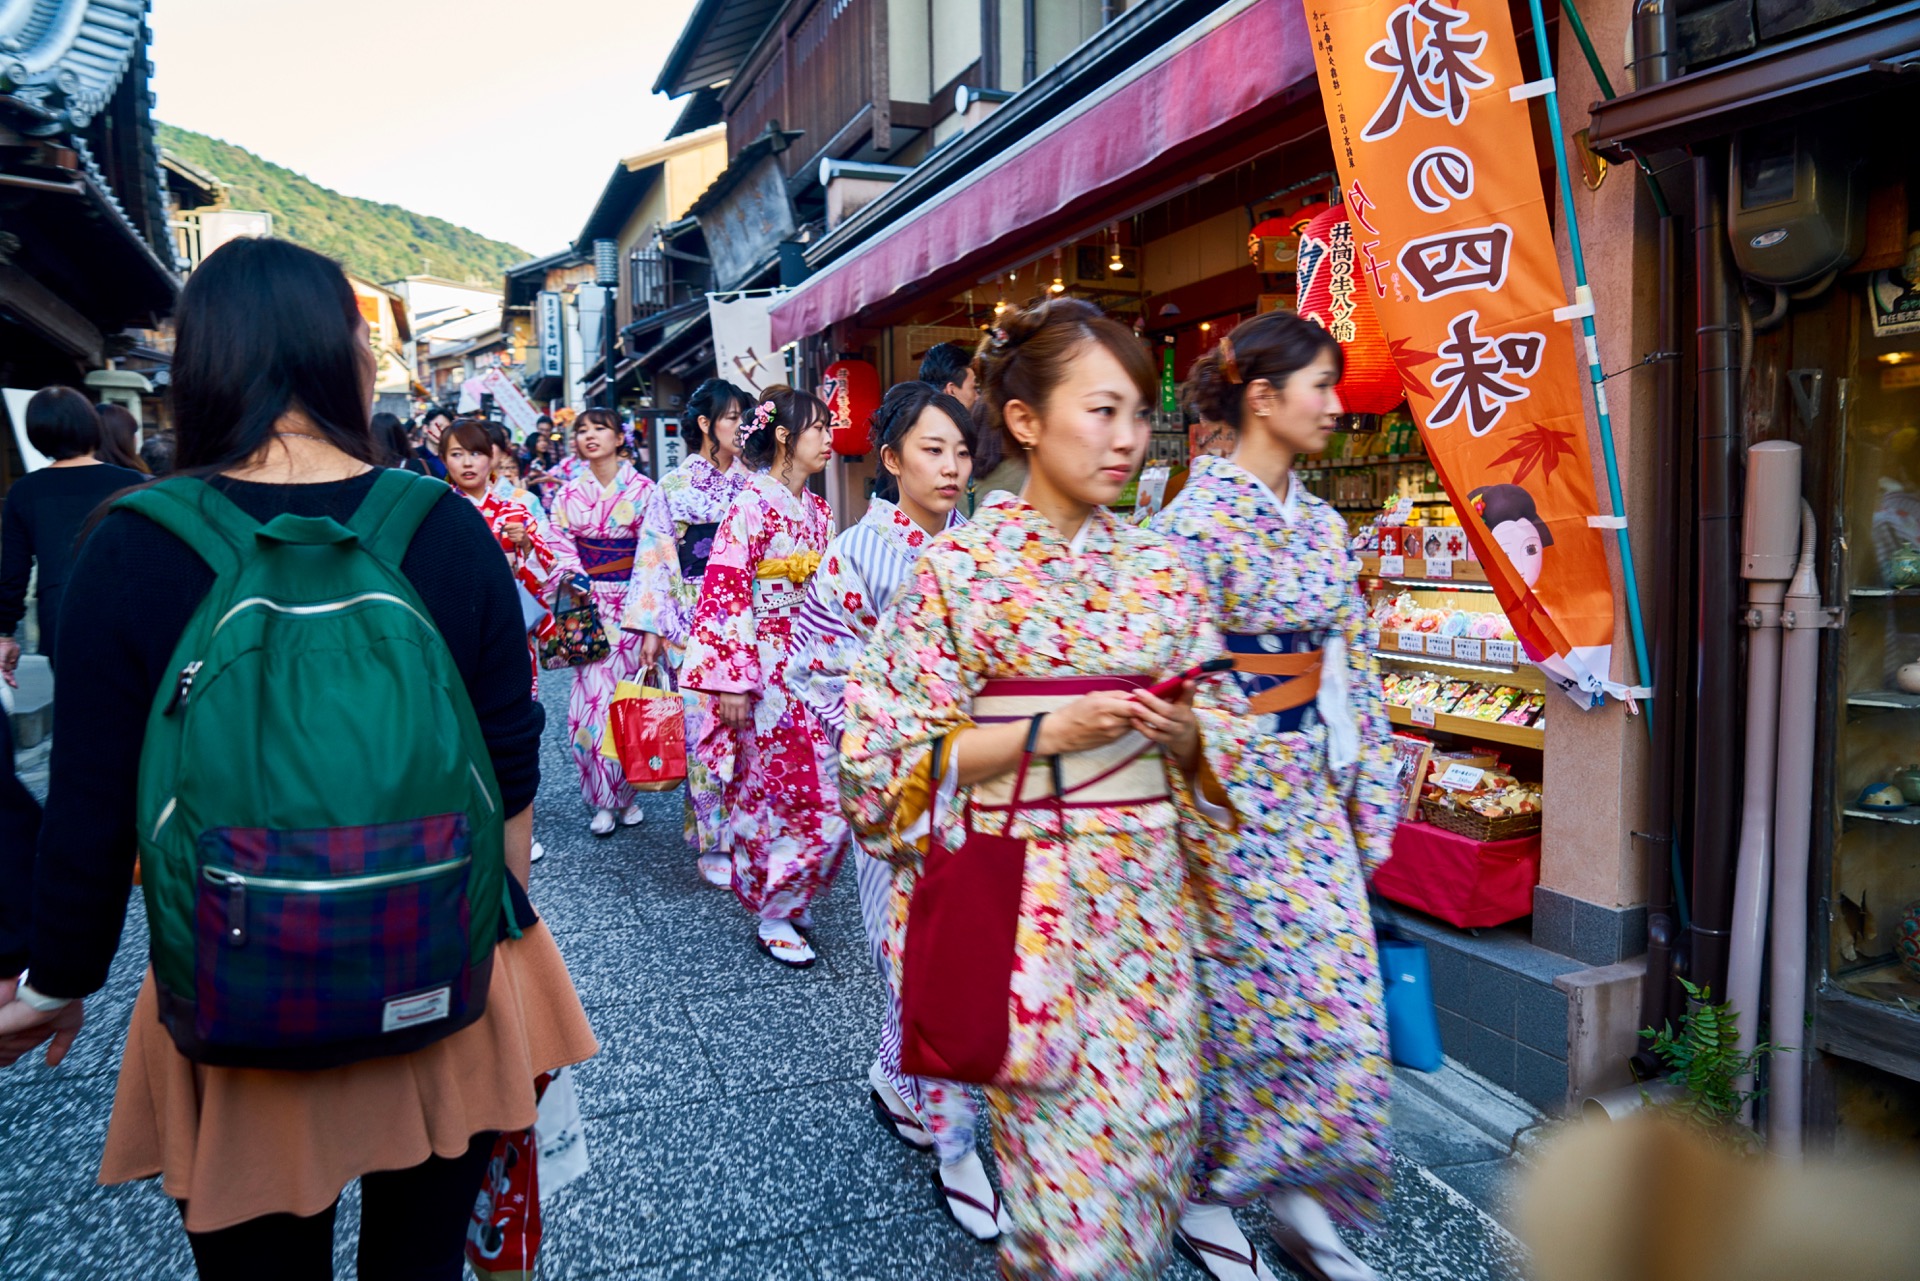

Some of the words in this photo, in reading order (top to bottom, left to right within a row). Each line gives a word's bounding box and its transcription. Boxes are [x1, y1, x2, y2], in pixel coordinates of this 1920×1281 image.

[1329, 221, 1356, 342] 井筒の生八ツ橋
